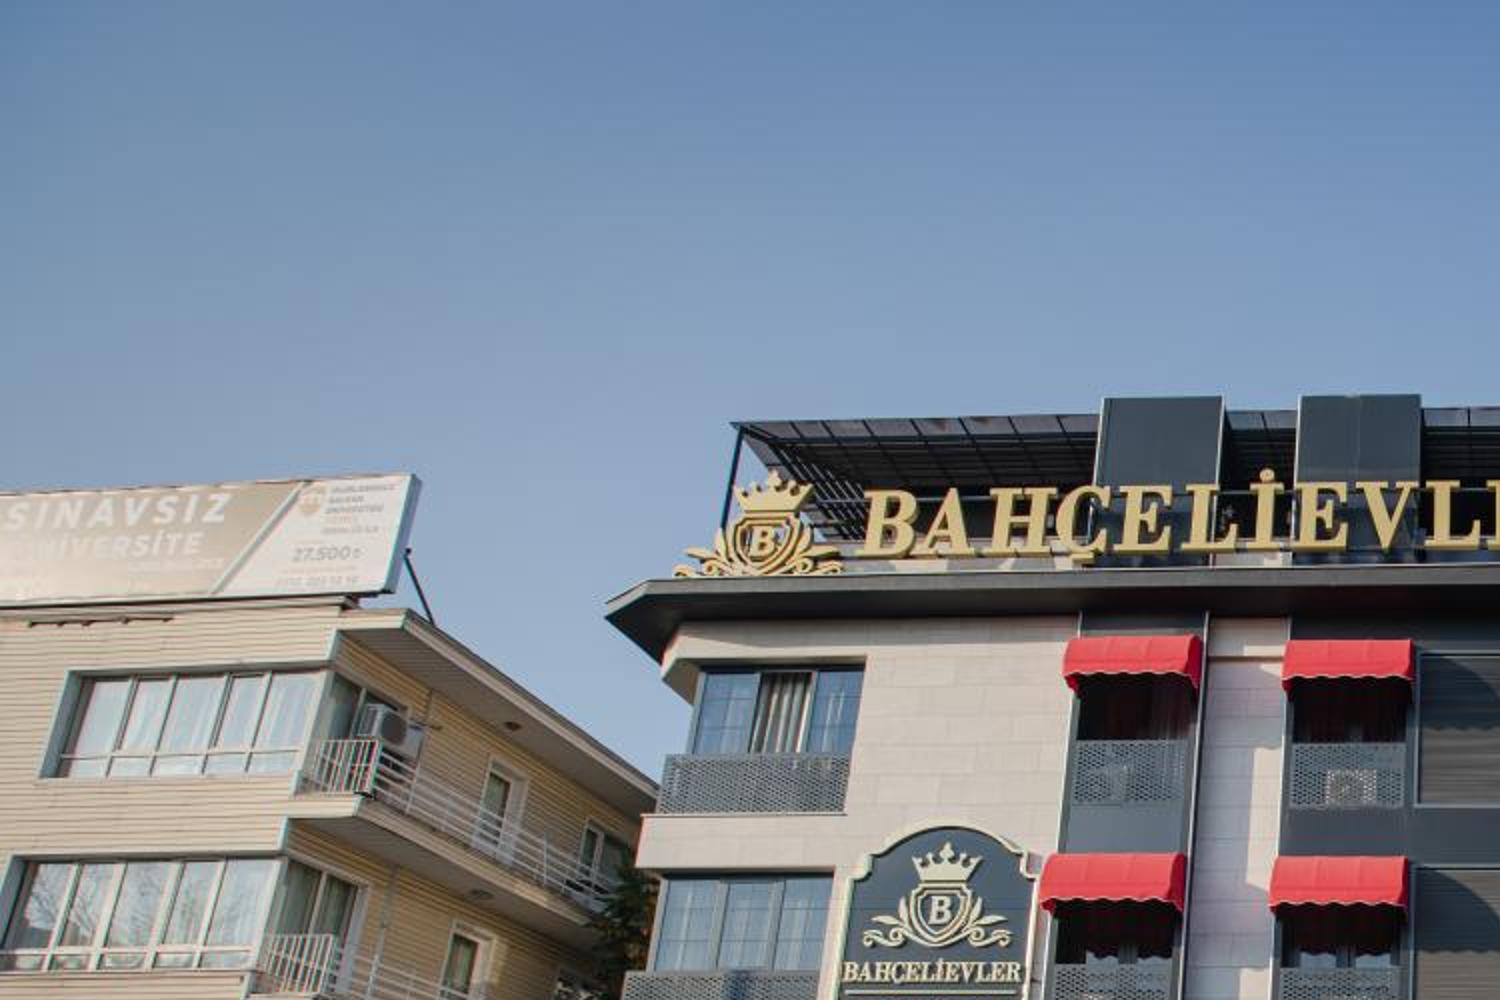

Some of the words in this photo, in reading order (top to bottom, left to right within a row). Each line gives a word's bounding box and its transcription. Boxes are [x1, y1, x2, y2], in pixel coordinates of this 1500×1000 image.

[4, 494, 232, 532] SINAVSIZ
[928, 895, 952, 925] B
[843, 958, 1022, 985] BAHÇELİEVLER
